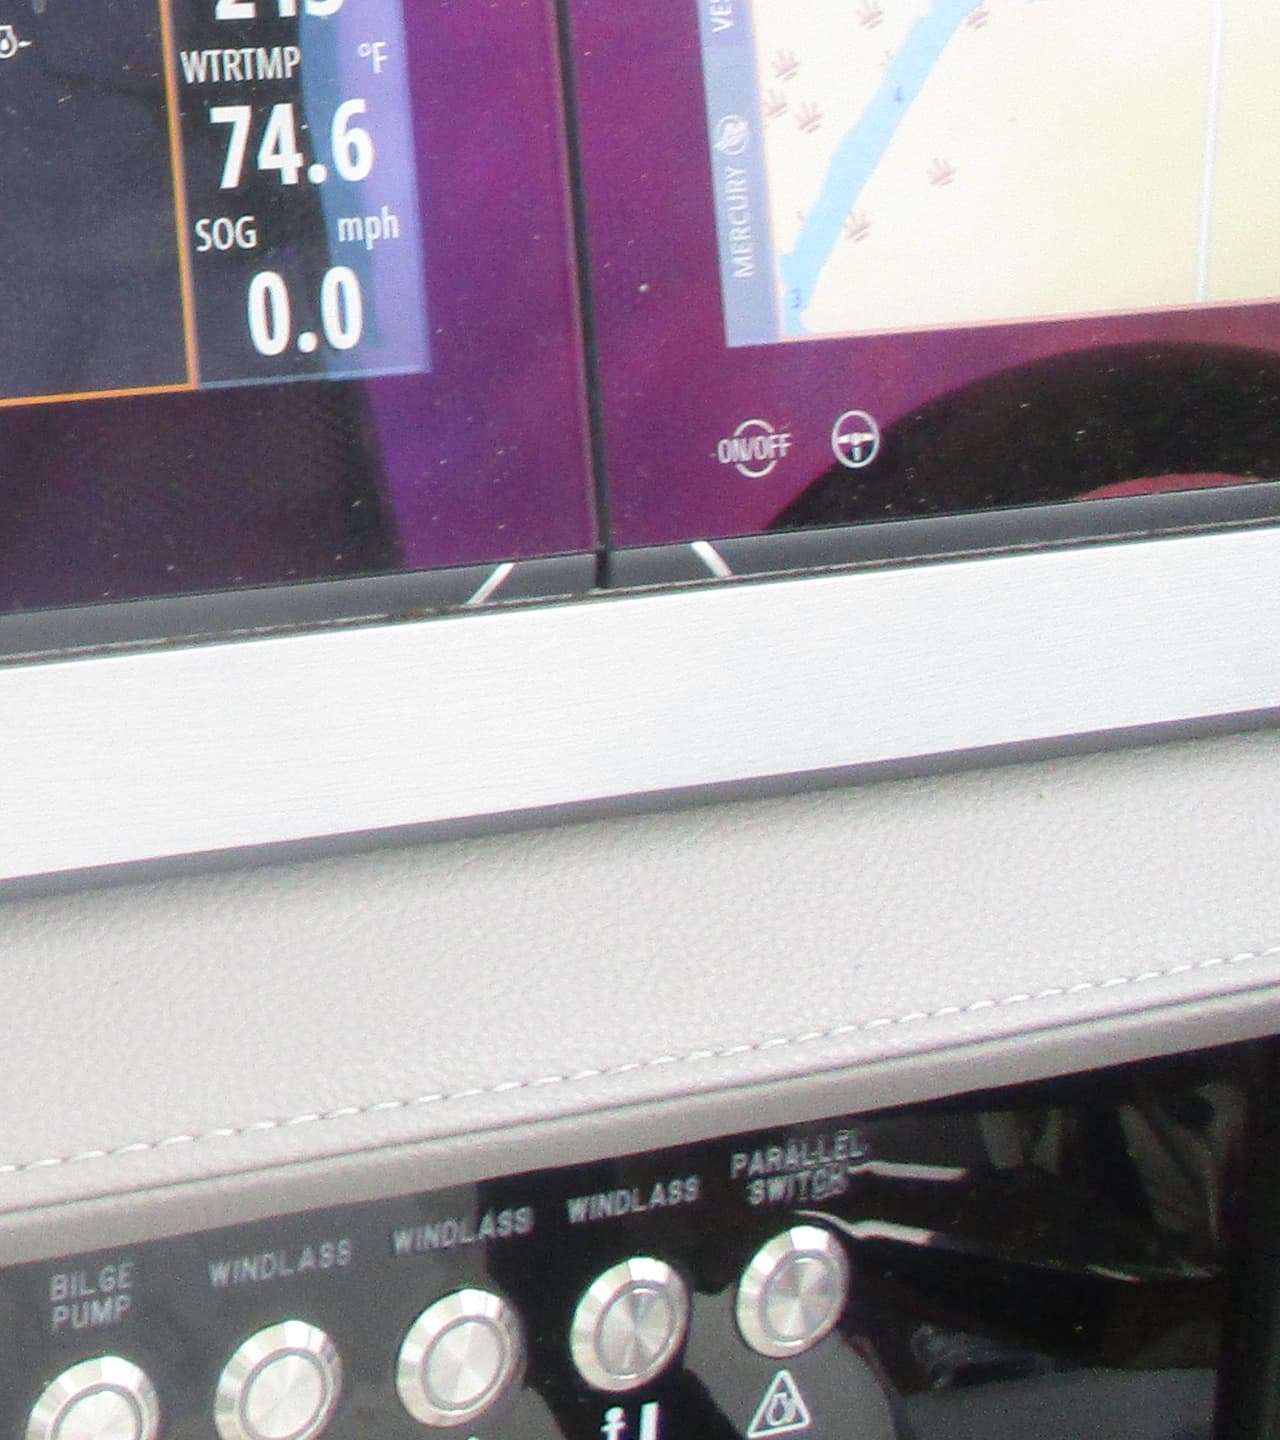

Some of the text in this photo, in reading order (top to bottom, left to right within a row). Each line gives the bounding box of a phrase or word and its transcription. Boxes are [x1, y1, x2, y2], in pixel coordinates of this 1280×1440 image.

[181, 45, 301, 85] WTRTMP
[209, 98, 375, 190] 74.6
[195, 215, 258, 252] SOG
[338, 205, 400, 250] mph
[721, 165, 755, 279] MERCURY
[246, 265, 363, 356] 0.0
[716, 433, 791, 465] ON/OFF
[566, 1173, 701, 1225] WINDLASS
[745, 1163, 849, 1206] SWITCH
[392, 1205, 535, 1256] WINDLASS
[49, 1261, 135, 1302] BILGE
[207, 1237, 353, 1289] WINDLASS
[51, 1295, 132, 1335] PUMP
